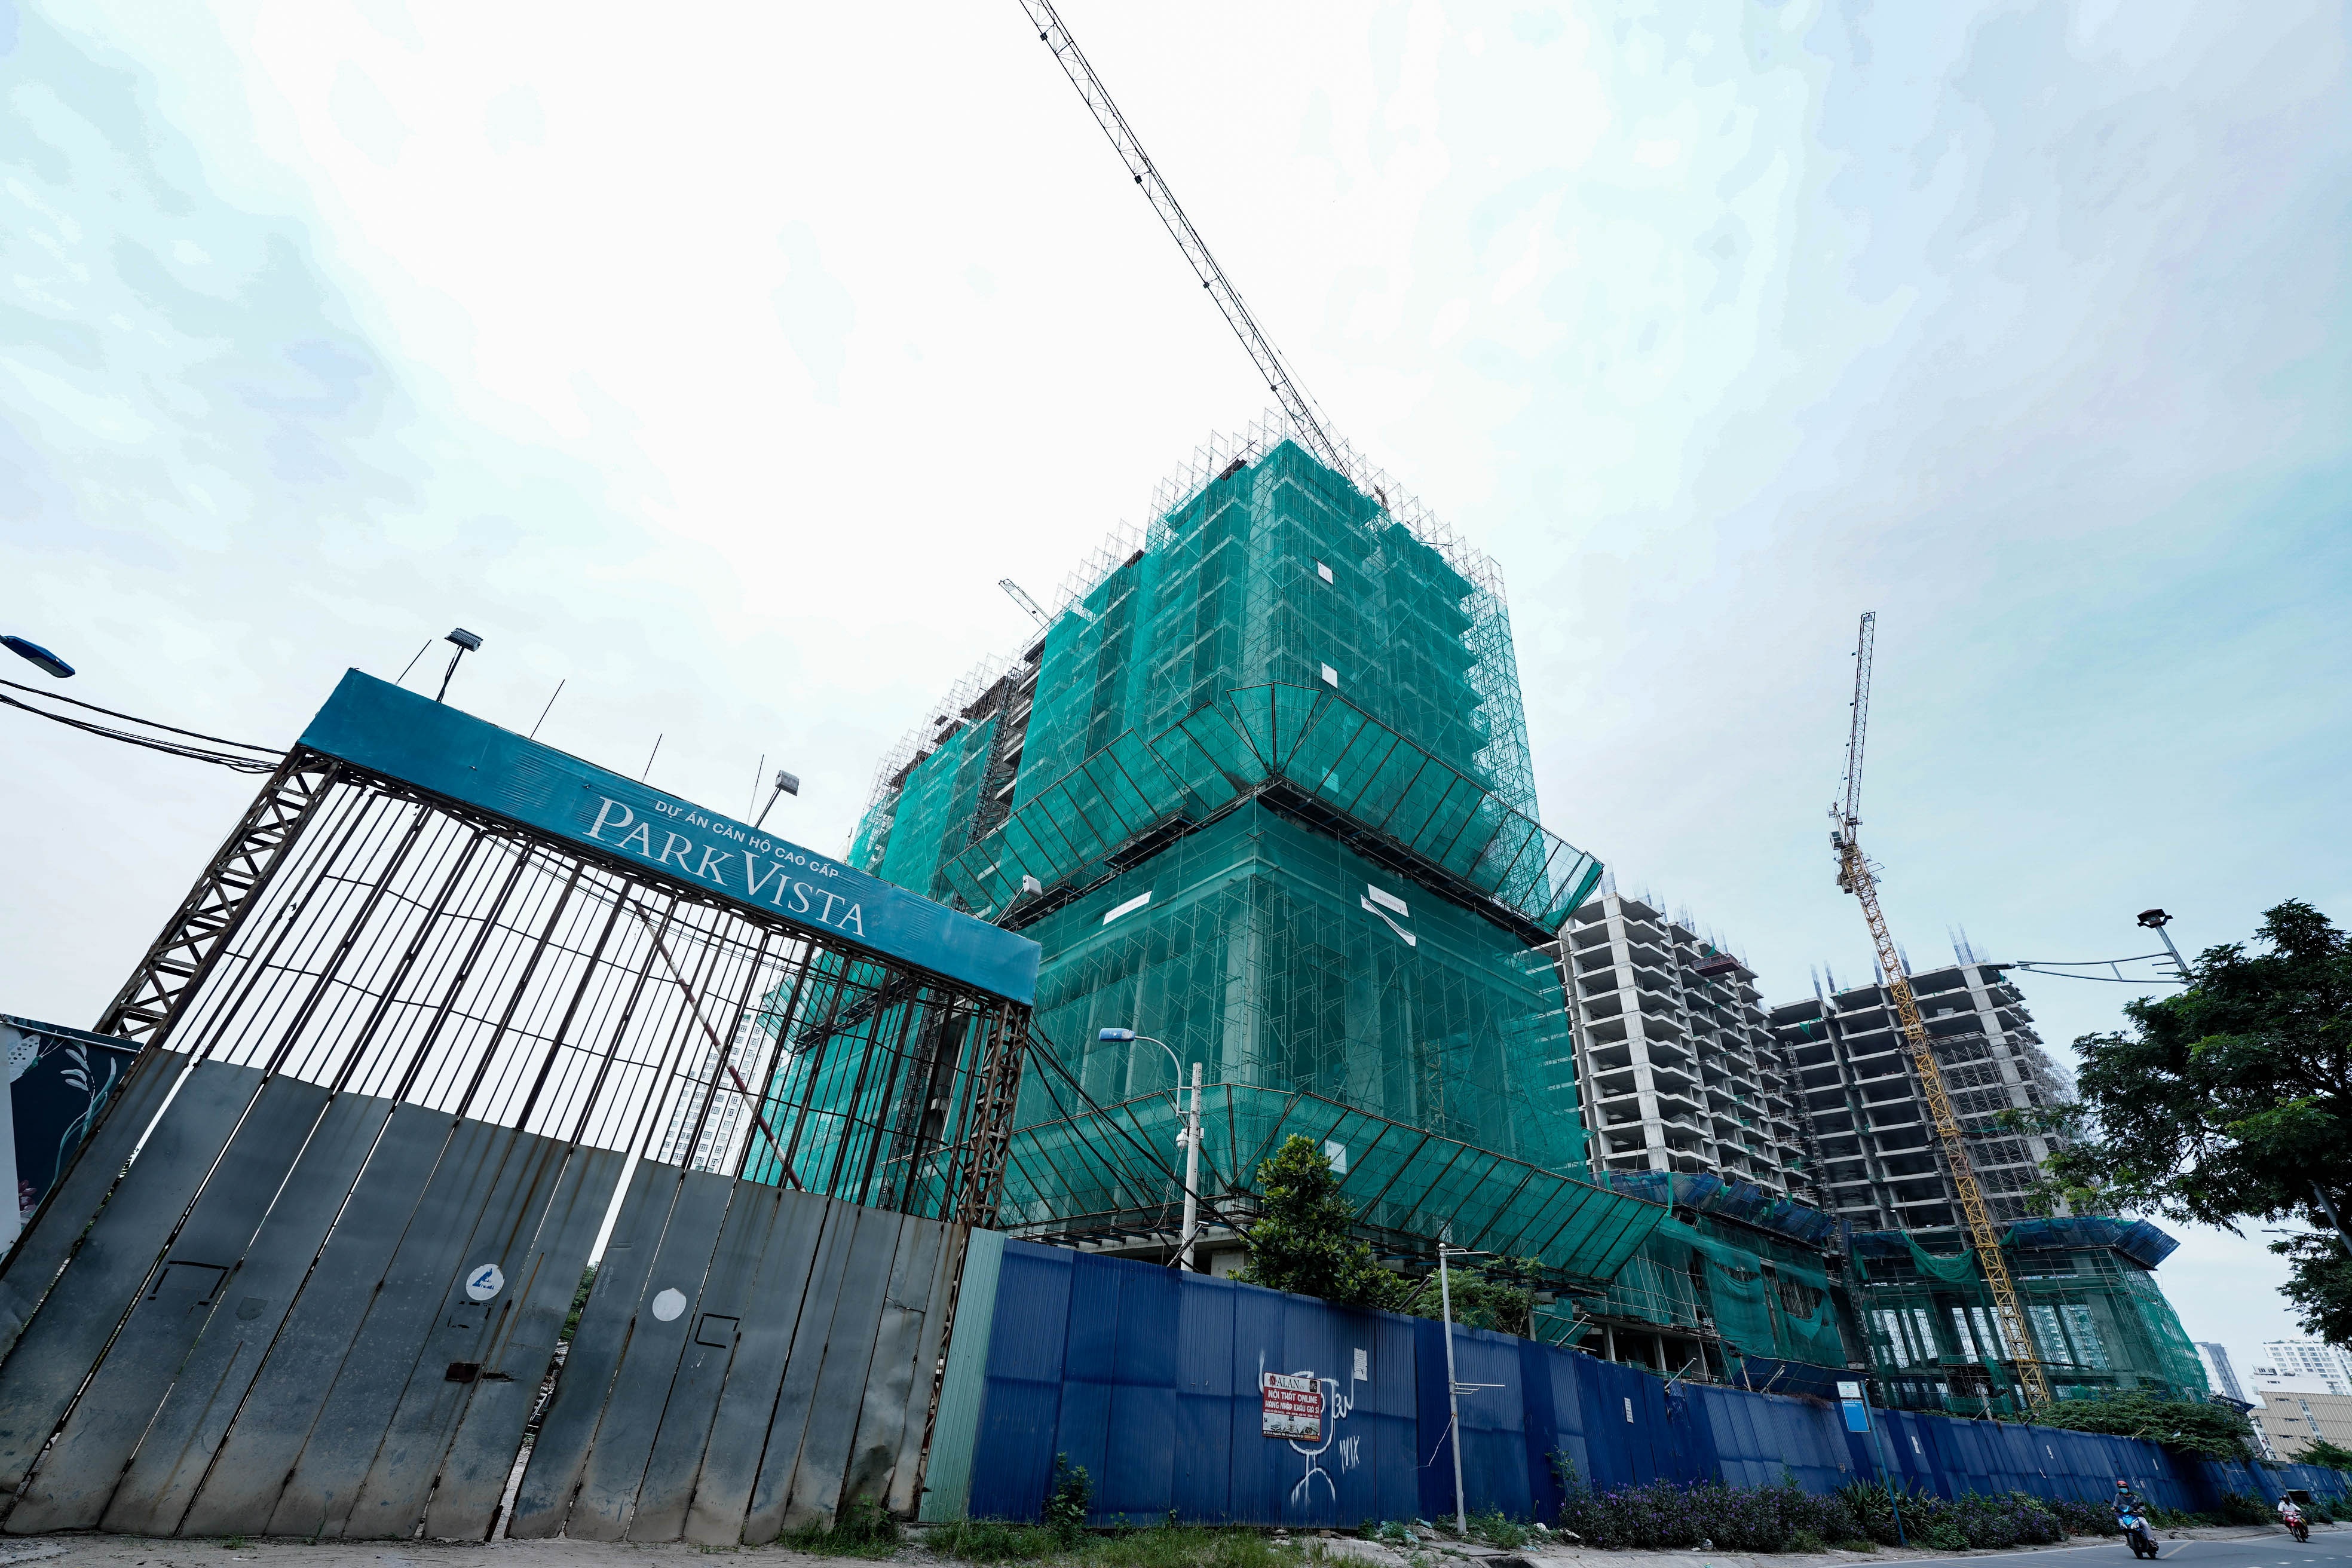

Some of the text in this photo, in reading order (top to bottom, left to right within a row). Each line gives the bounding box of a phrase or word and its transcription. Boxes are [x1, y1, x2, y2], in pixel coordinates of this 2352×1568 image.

[655, 801, 839, 878] DỰ ÁN CĂN HỘ CAO CẤP
[582, 796, 866, 938] PARK VISTA
[1265, 1399, 1279, 1408] HÀNG
[1268, 1389, 1317, 1404] NỘI THẤT ONLINE
